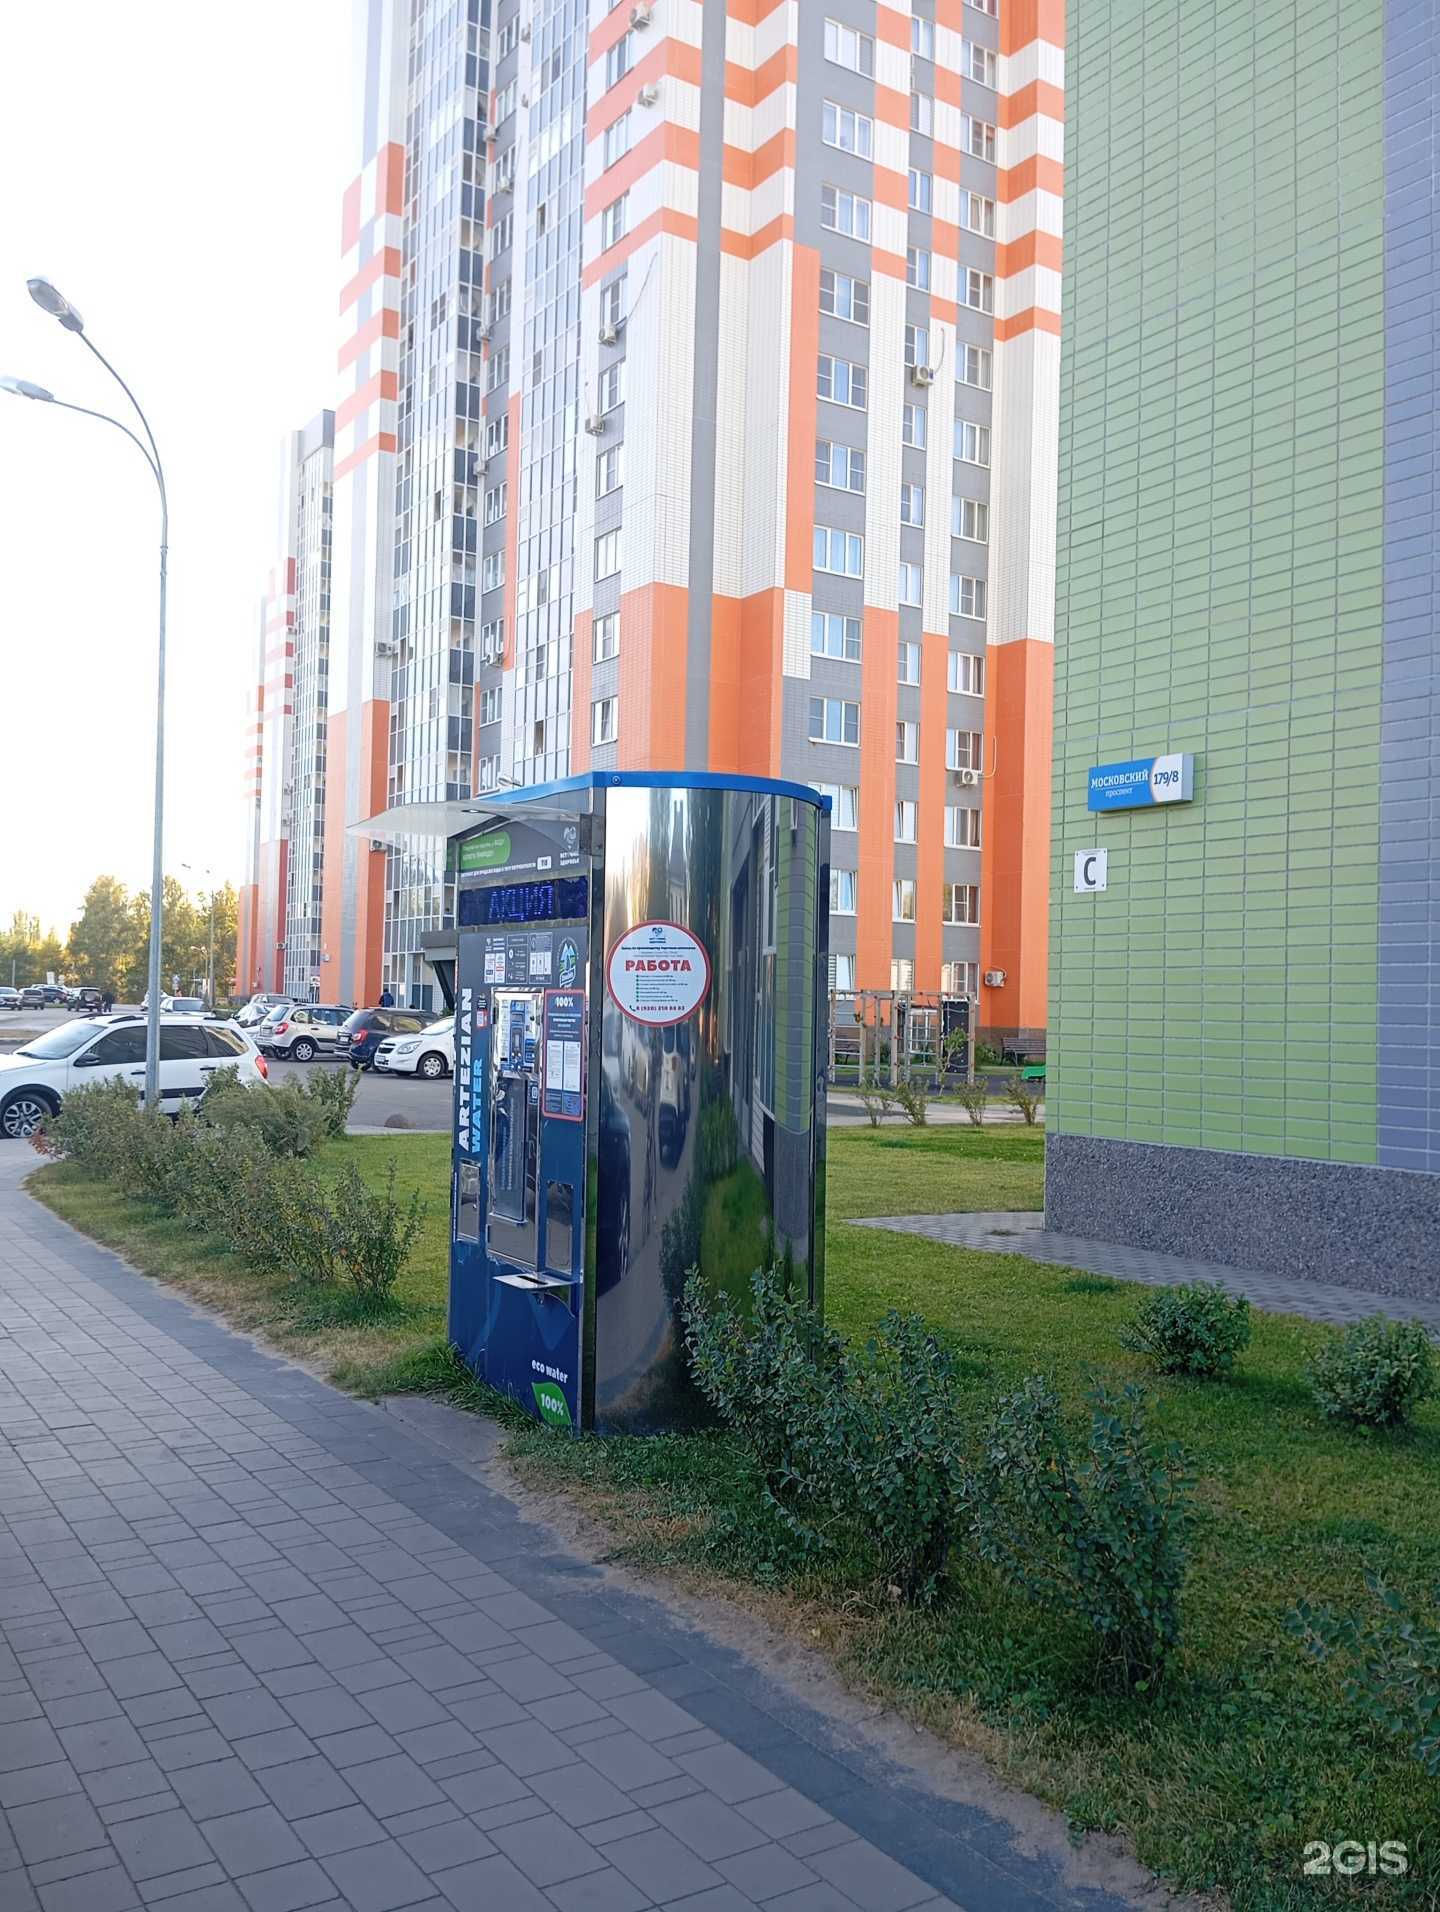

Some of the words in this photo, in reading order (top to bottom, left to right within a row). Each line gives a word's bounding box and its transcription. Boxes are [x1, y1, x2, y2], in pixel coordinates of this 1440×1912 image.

[1091, 769, 1149, 789] МОСКОВСКИЙ
[1153, 770, 1179, 786] 179/8
[488, 884, 553, 920] АКЦИЯ
[625, 960, 692, 971] РАБОТА
[555, 996, 574, 1008] 100%
[458, 988, 472, 1151] ARTEZIAN
[472, 1058, 483, 1153] WATER
[531, 1360, 545, 1373] eco
[545, 1365, 568, 1384] water
[541, 1393, 564, 1416] 100%
